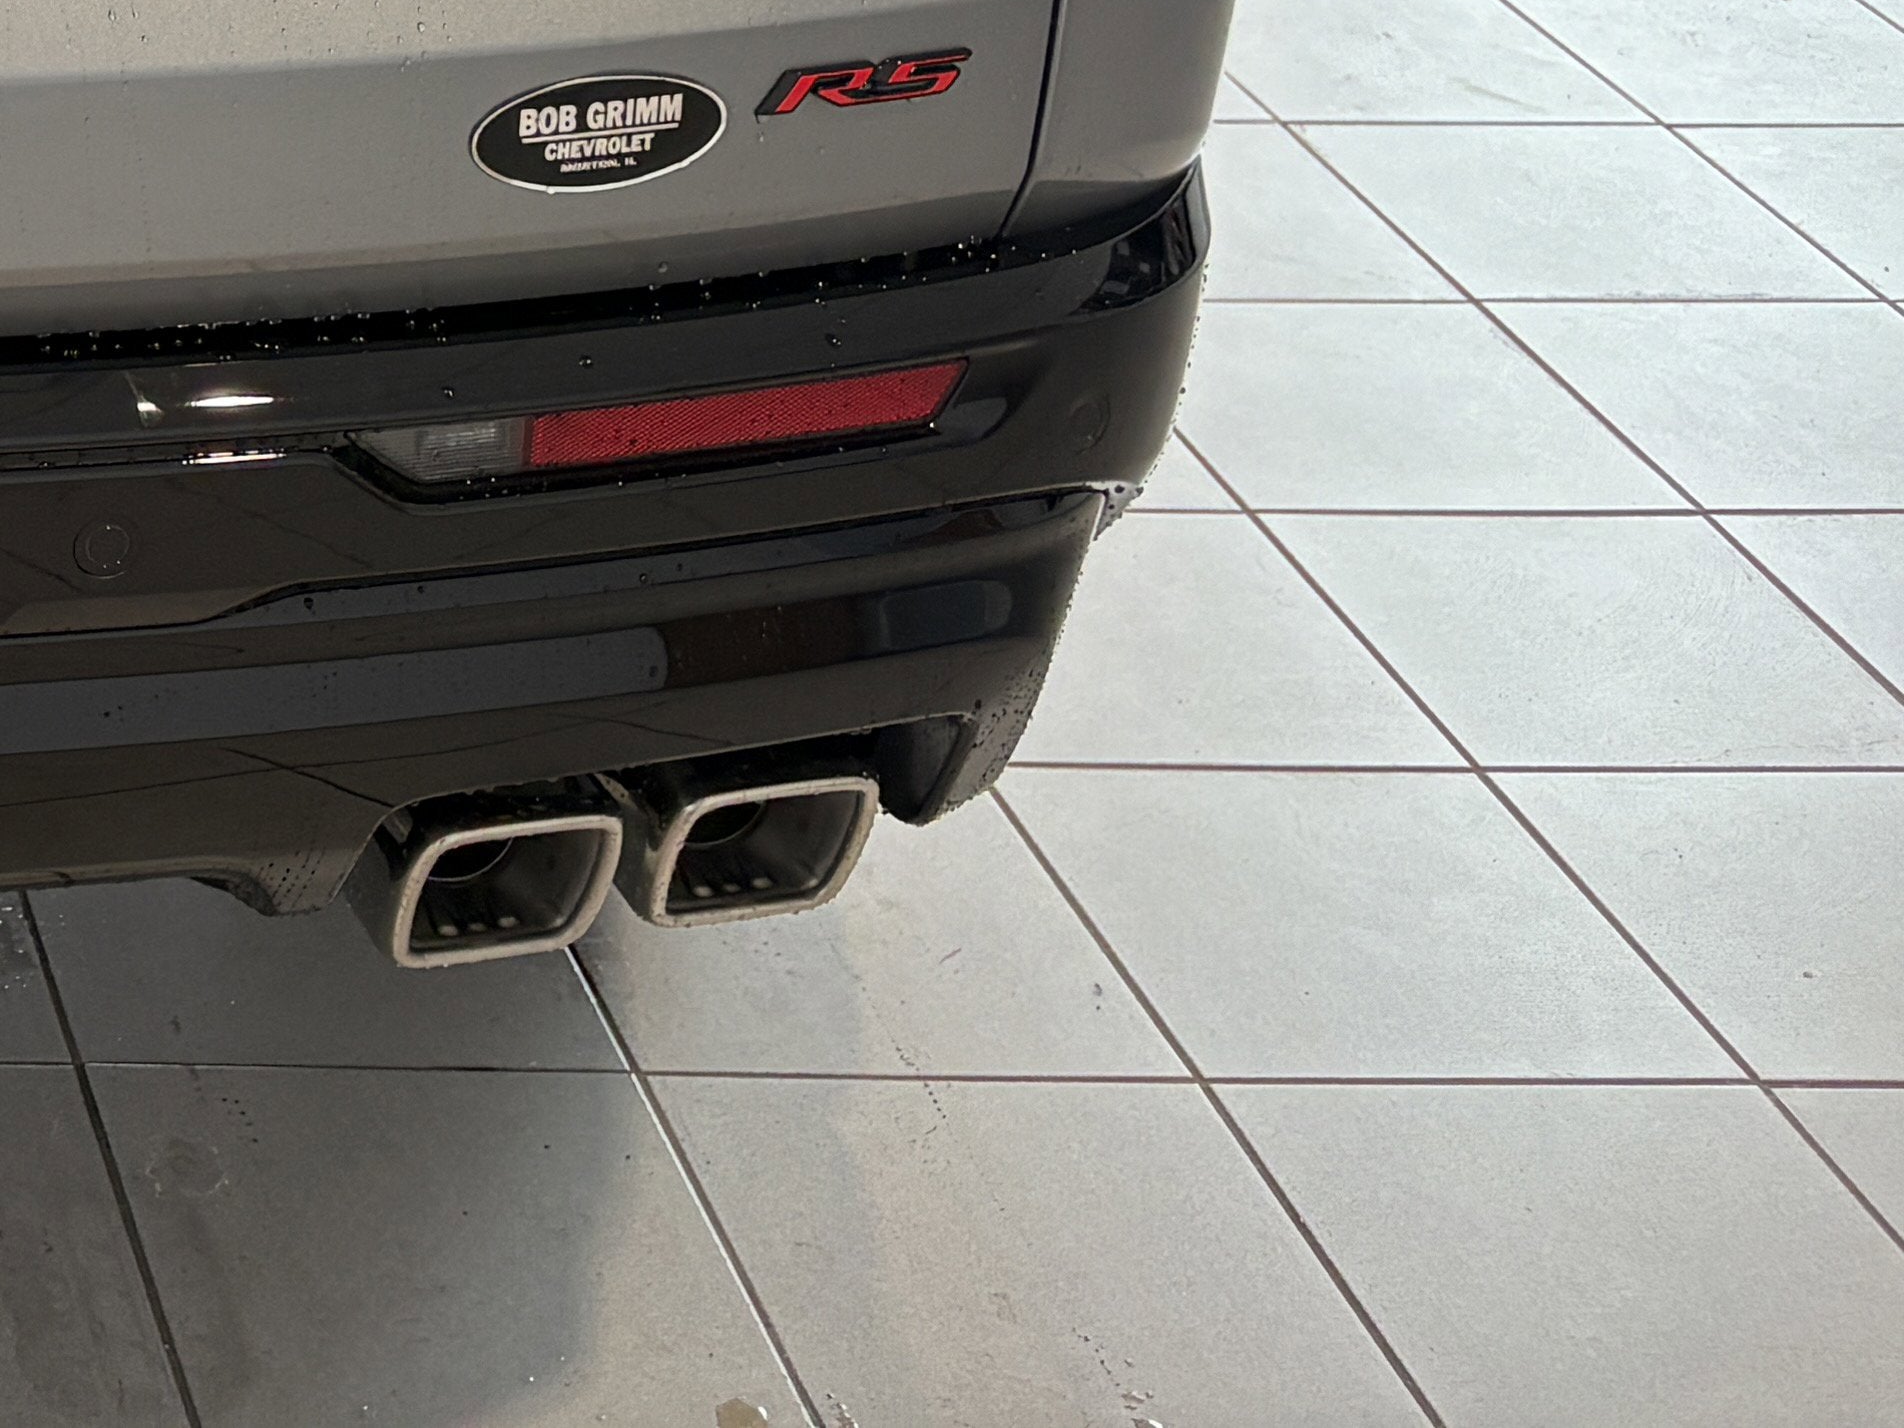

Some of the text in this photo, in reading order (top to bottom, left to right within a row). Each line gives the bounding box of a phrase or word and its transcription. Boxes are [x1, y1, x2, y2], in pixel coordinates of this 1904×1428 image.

[754, 47, 973, 115] RS
[519, 93, 684, 137] BOB GRIMM
[544, 132, 656, 161] CHEVROLET
